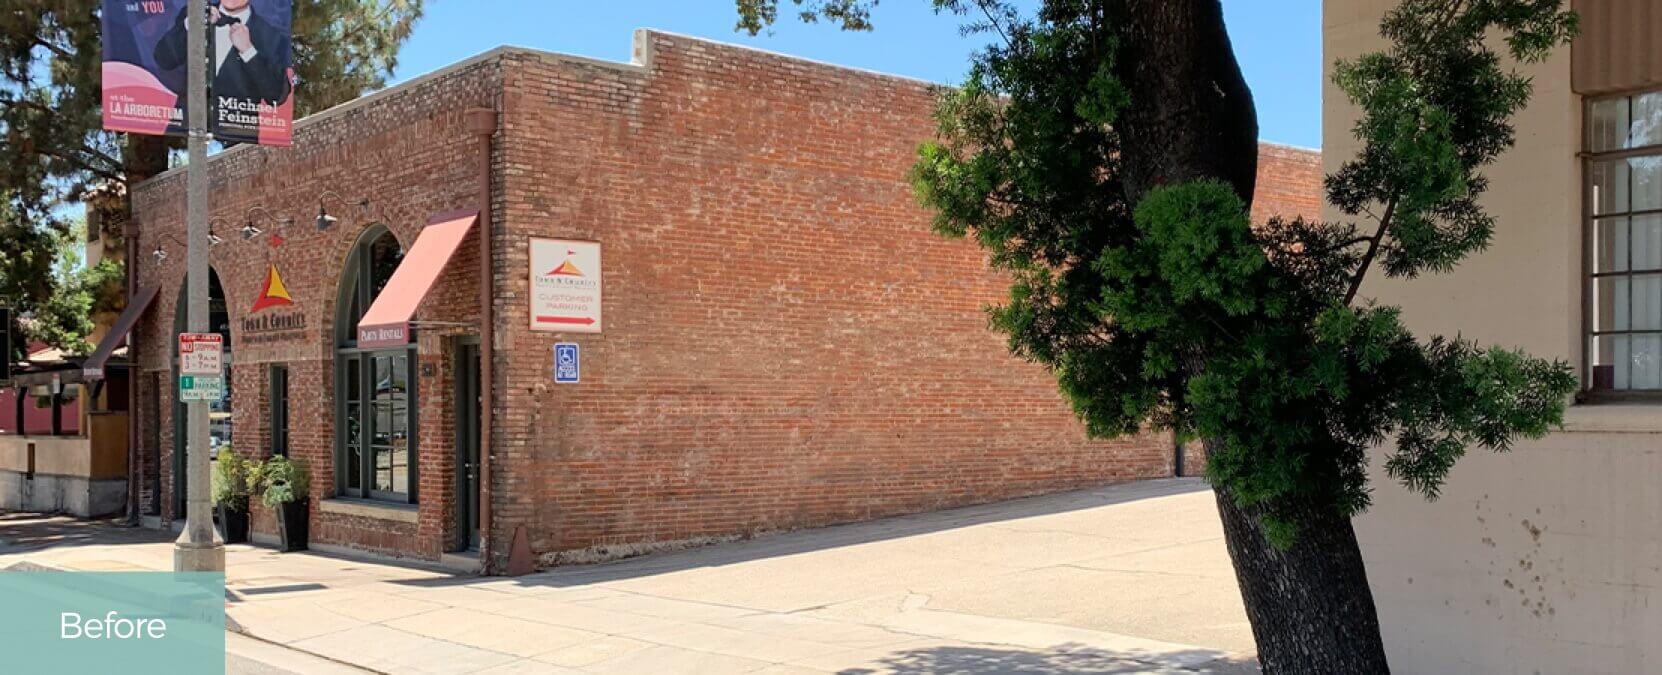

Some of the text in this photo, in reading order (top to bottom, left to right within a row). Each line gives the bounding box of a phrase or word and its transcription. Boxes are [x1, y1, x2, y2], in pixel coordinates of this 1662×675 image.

[126, 1, 165, 13] and YOU
[110, 102, 121, 113] LA
[124, 105, 183, 121] ARBORETUM
[218, 96, 278, 114] Michael
[218, 109, 287, 127] Feinstein
[539, 293, 593, 303] CUSTOMER
[546, 302, 588, 312] PARKING
